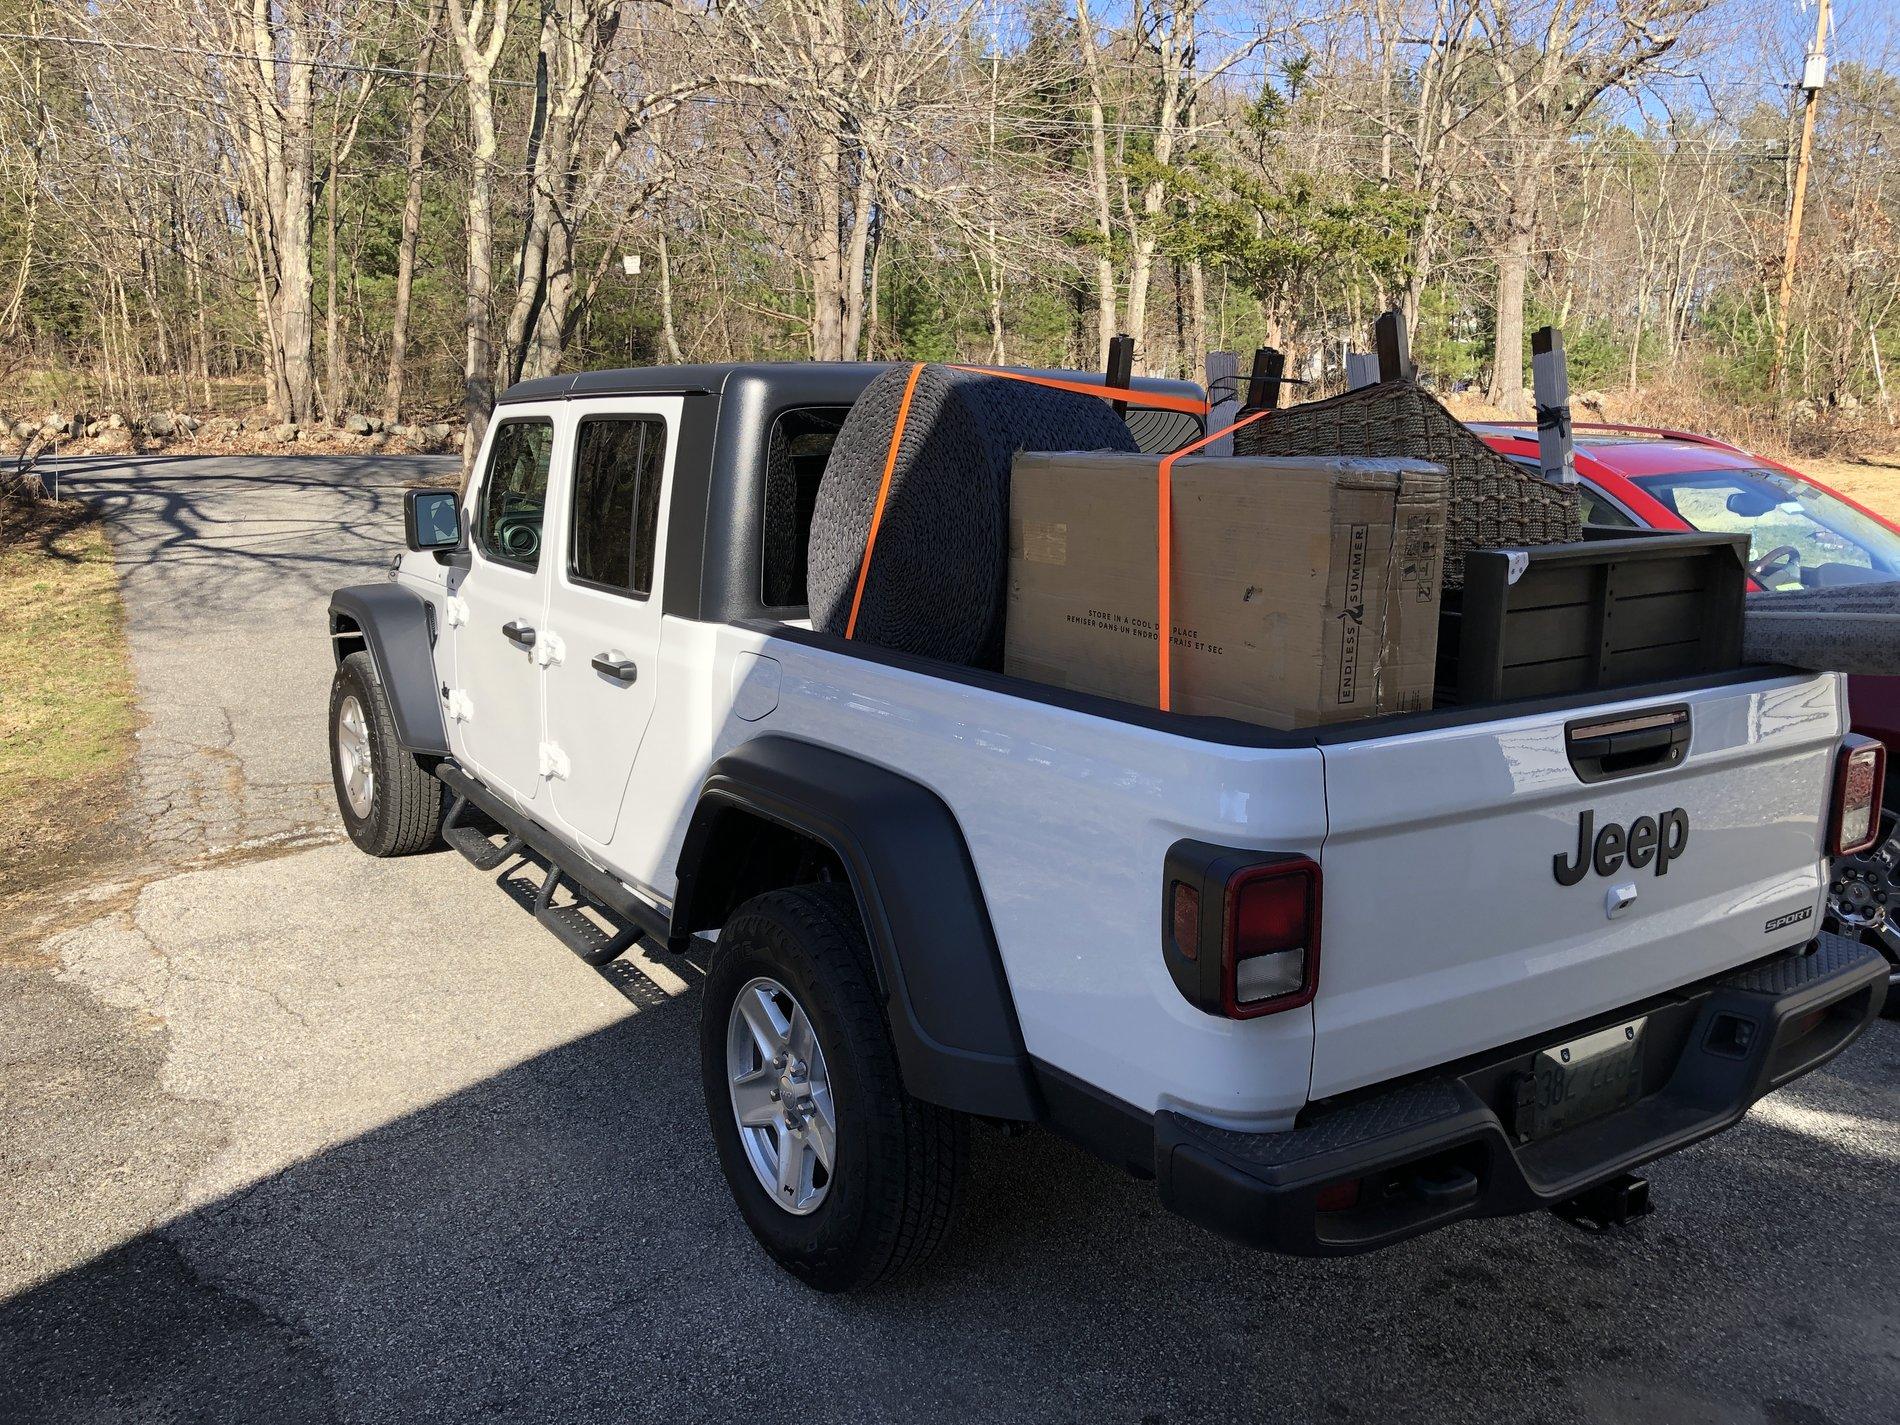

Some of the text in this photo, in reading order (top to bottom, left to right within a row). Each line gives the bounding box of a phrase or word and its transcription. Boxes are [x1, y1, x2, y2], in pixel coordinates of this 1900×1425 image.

[1066, 614, 1223, 655] REMISER DANS UN ENDRO FRAIS ET SEC
[1088, 609, 1111, 621] STORE
[1114, 613, 1121, 623] IN
[1123, 616, 1129, 624] A
[1131, 618, 1152, 630] COOL
[1173, 626, 1198, 639] PLACE
[1343, 627, 1355, 698] ENDLESS
[1553, 807, 1689, 887] Jeep
[1764, 906, 1813, 932] SPORT
